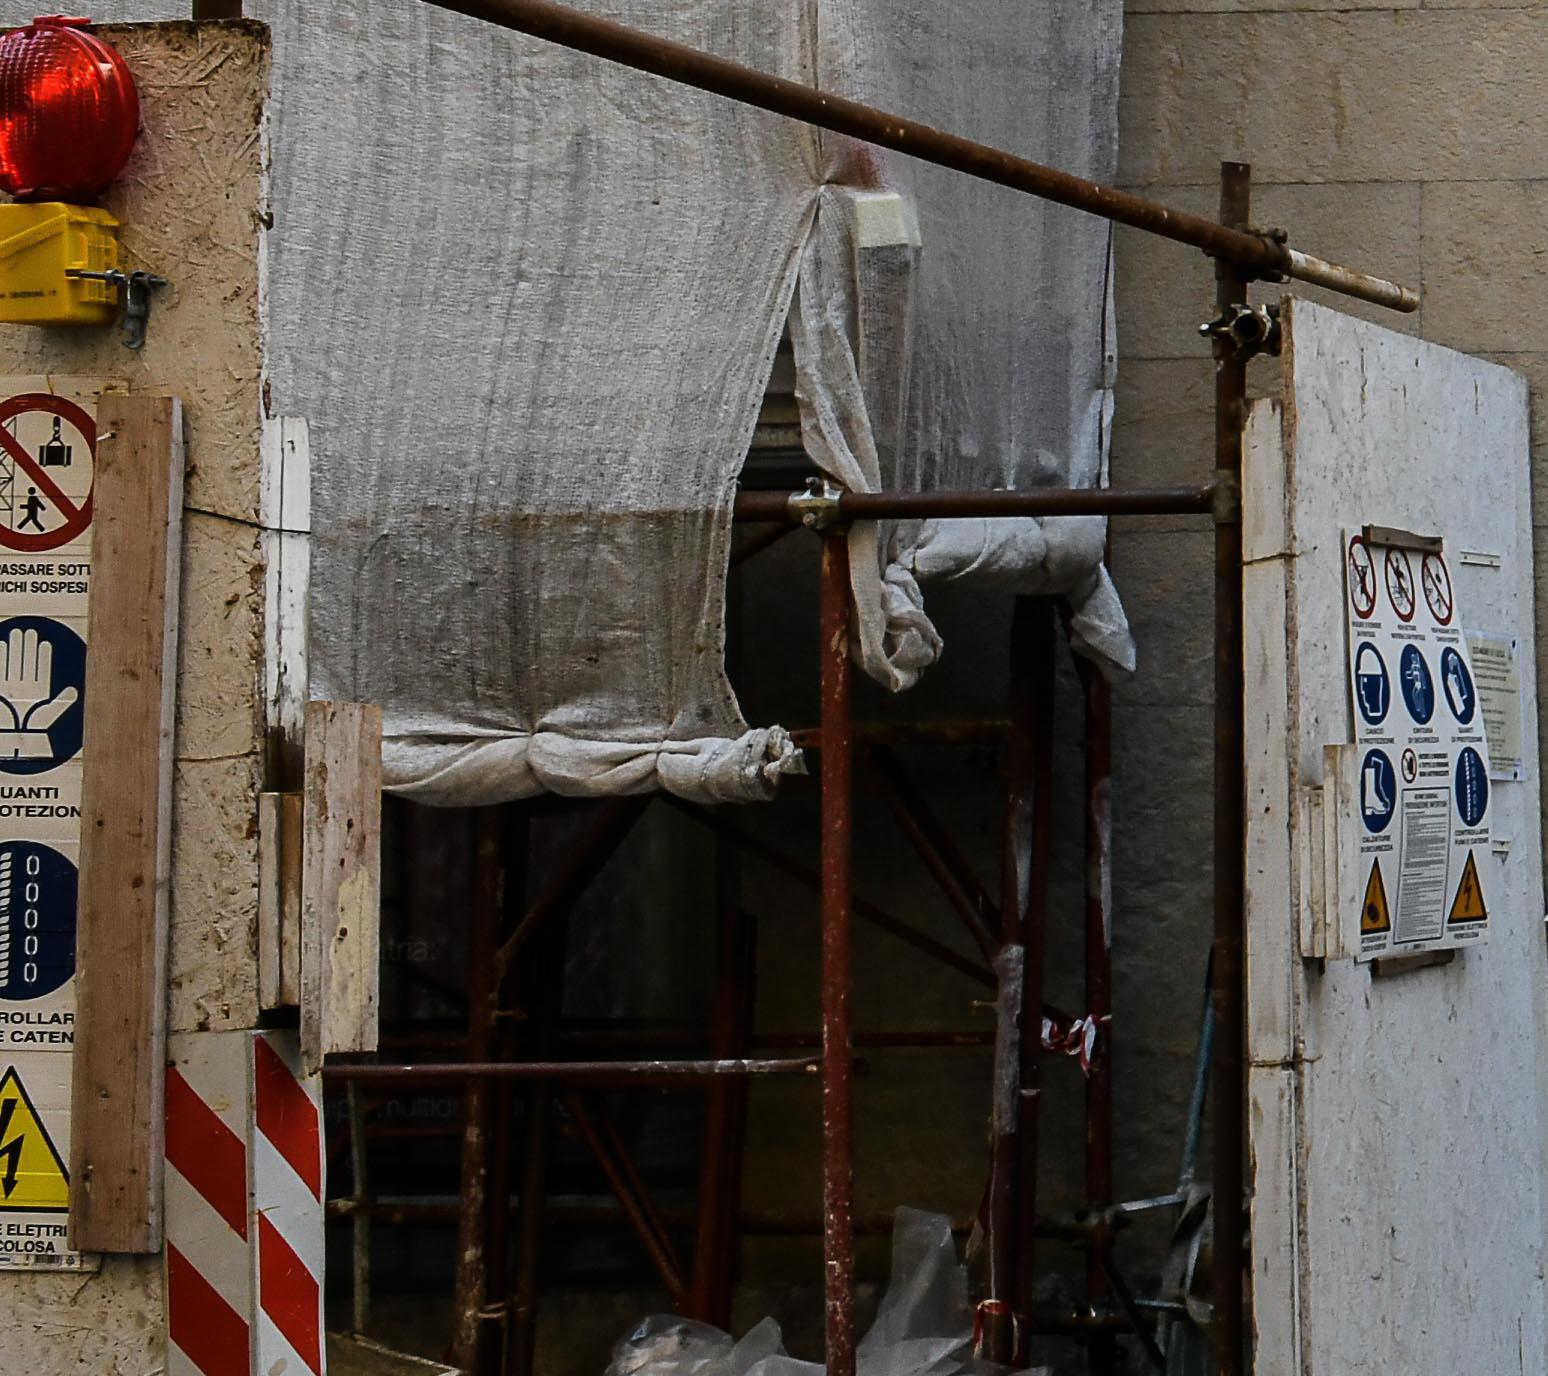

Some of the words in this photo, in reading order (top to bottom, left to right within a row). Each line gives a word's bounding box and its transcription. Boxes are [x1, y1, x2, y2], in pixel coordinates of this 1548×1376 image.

[0, 564, 54, 575] ASSARE
[58, 564, 91, 575] SOTT
[0, 581, 27, 593] ICHI
[31, 581, 88, 593] SOSPESI
[0, 787, 59, 799] UANTI
[0, 805, 81, 818] OTEZION
[0, 1012, 75, 1024] ROLLAR
[11, 1031, 74, 1043] CATEN
[7, 1224, 68, 1238] ELETTRI
